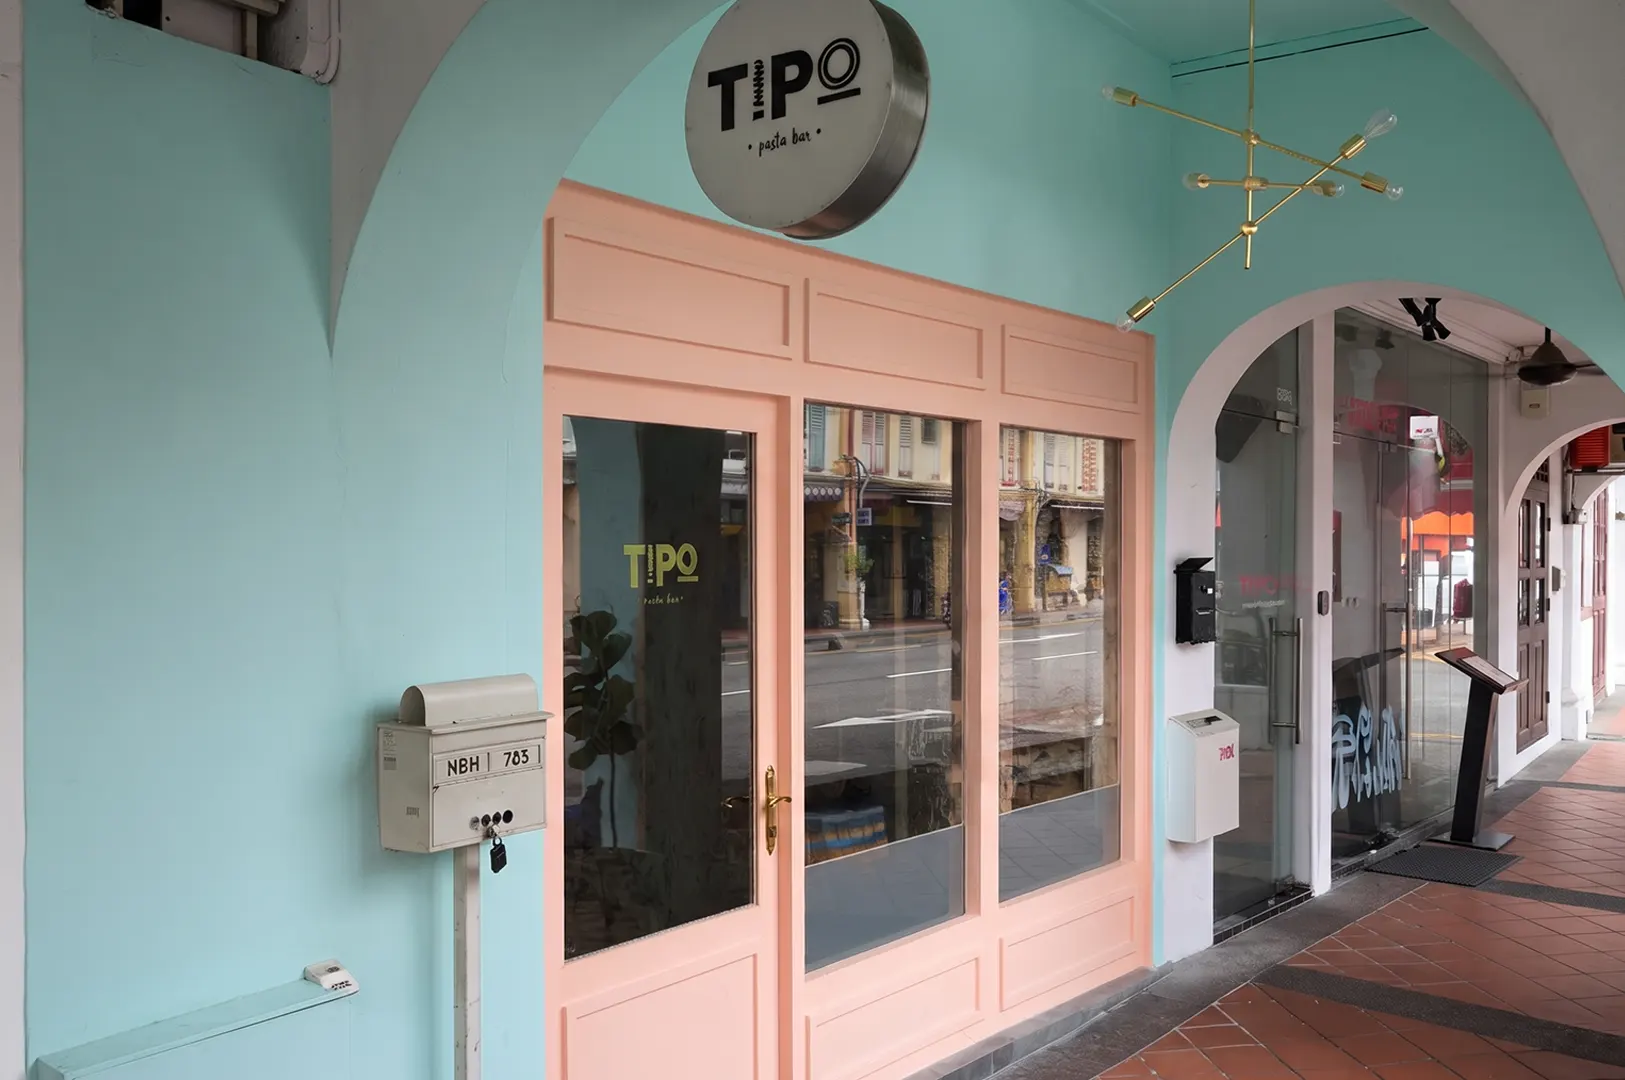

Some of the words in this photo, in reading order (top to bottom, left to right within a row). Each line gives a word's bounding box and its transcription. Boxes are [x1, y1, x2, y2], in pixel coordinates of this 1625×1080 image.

[758, 131, 787, 157] pasta
[792, 127, 811, 144] bar
[447, 755, 480, 777] NBH
